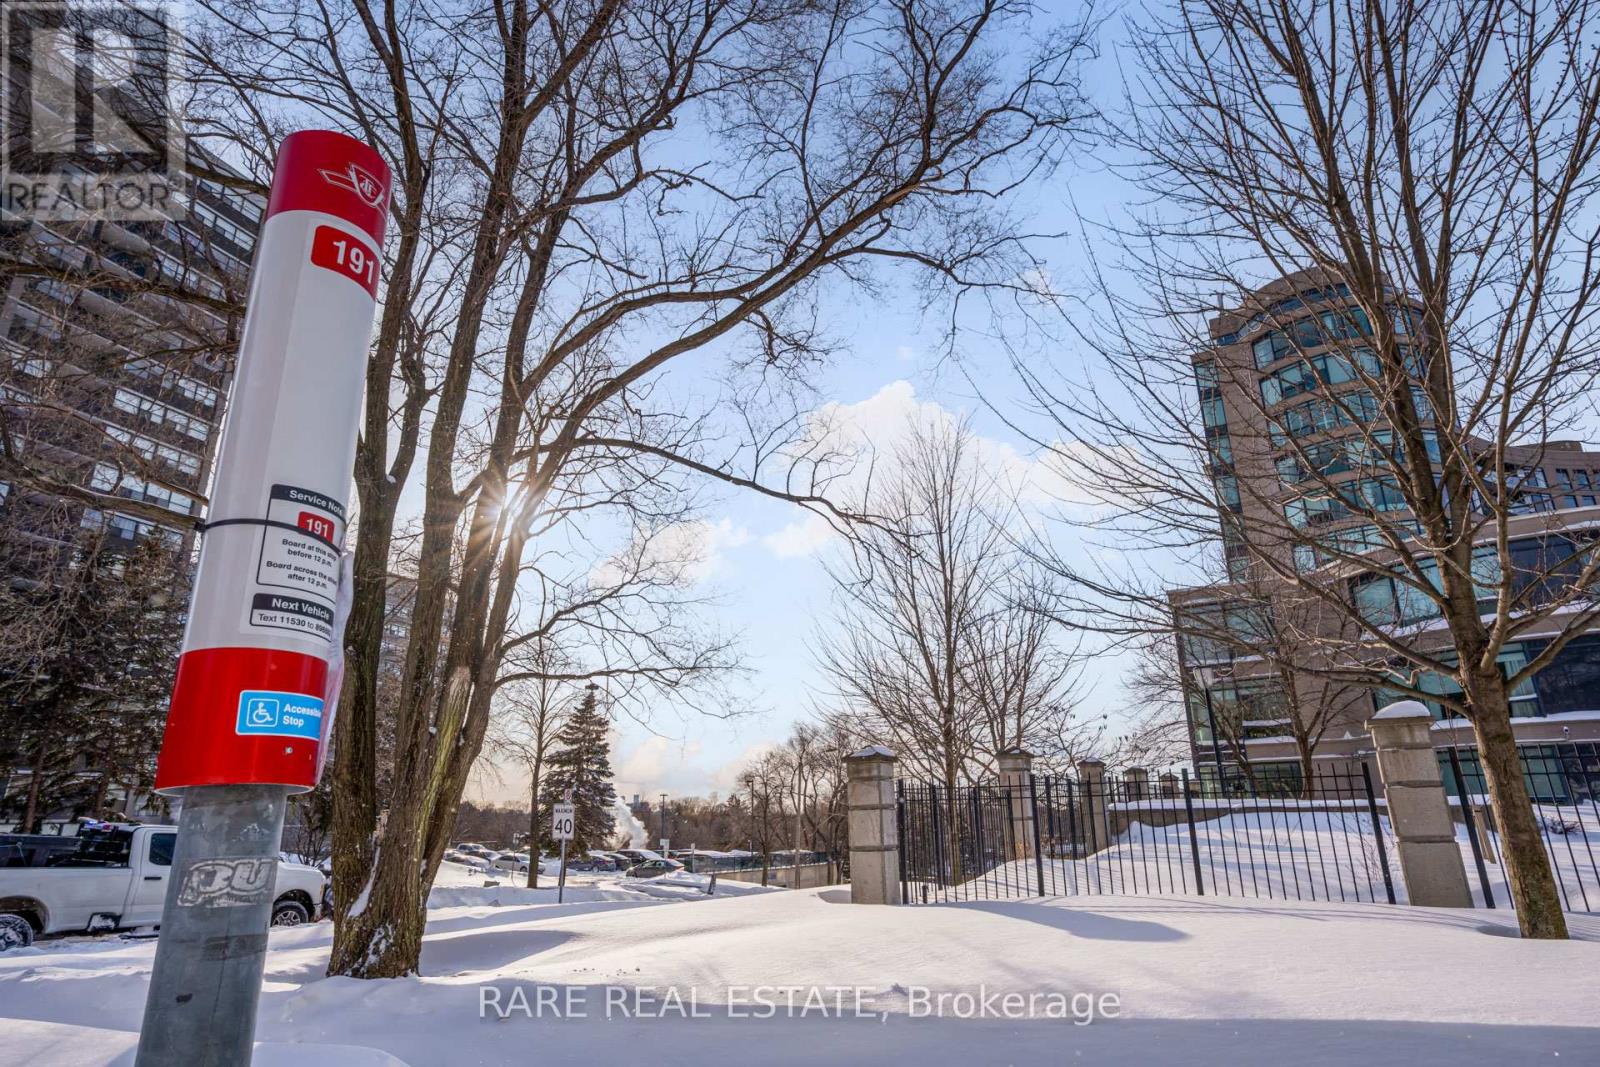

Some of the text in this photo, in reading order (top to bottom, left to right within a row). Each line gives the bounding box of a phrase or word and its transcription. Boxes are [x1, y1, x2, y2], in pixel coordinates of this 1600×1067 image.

[332, 240, 375, 284] 191
[289, 490, 327, 507] Service
[306, 518, 329, 538] 191
[282, 538, 306, 549] Board
[315, 546, 327, 556] this
[288, 549, 313, 560] before
[266, 561, 327, 580] Board across the
[288, 573, 306, 582] after
[272, 598, 330, 620] Next Vehicle
[259, 613, 277, 623] Text
[280, 615, 306, 627] 11530
[307, 621, 315, 629] to
[283, 715, 305, 728] Stop
[554, 818, 572, 834] 40
